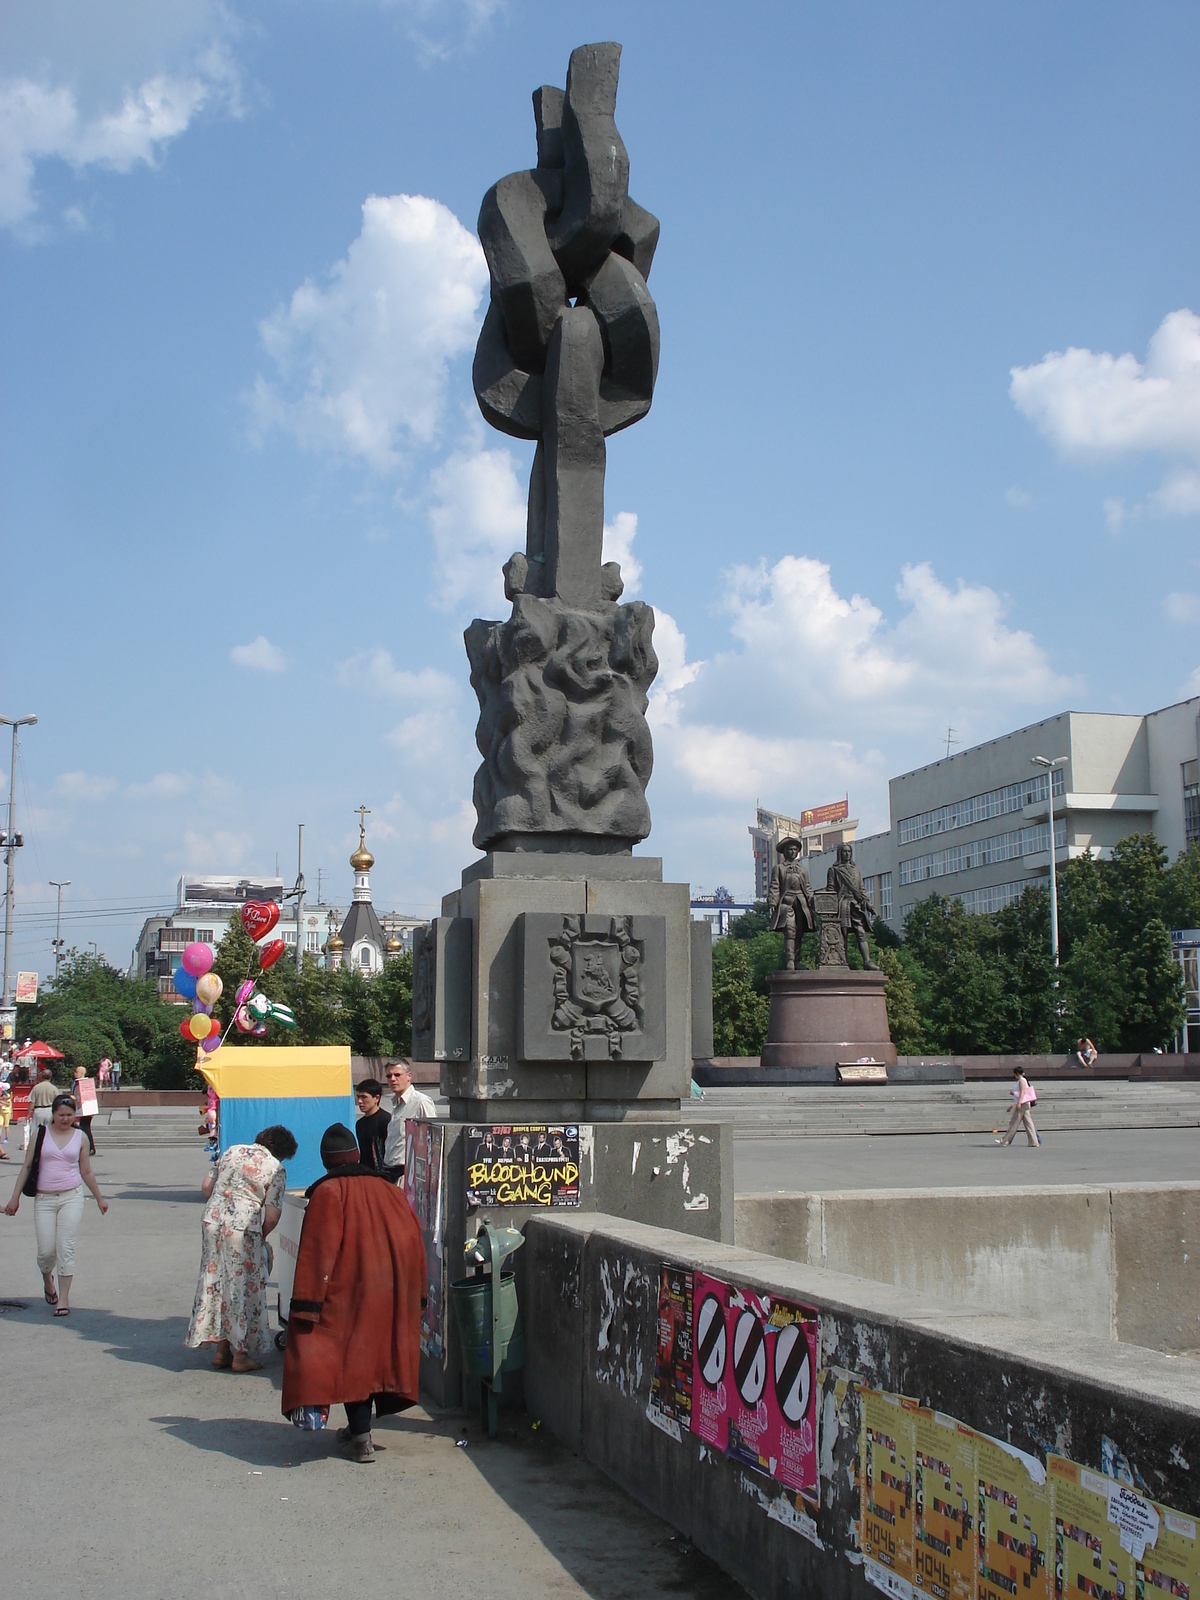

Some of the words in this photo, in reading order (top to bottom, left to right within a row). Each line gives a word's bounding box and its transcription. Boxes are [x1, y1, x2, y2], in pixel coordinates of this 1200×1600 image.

[467, 1161, 579, 1187] BLOODHOUND
[497, 1182, 552, 1206] GANG
[866, 1518, 896, 1555] НОЧЬ
[915, 1547, 951, 1589] НОЧЬ
